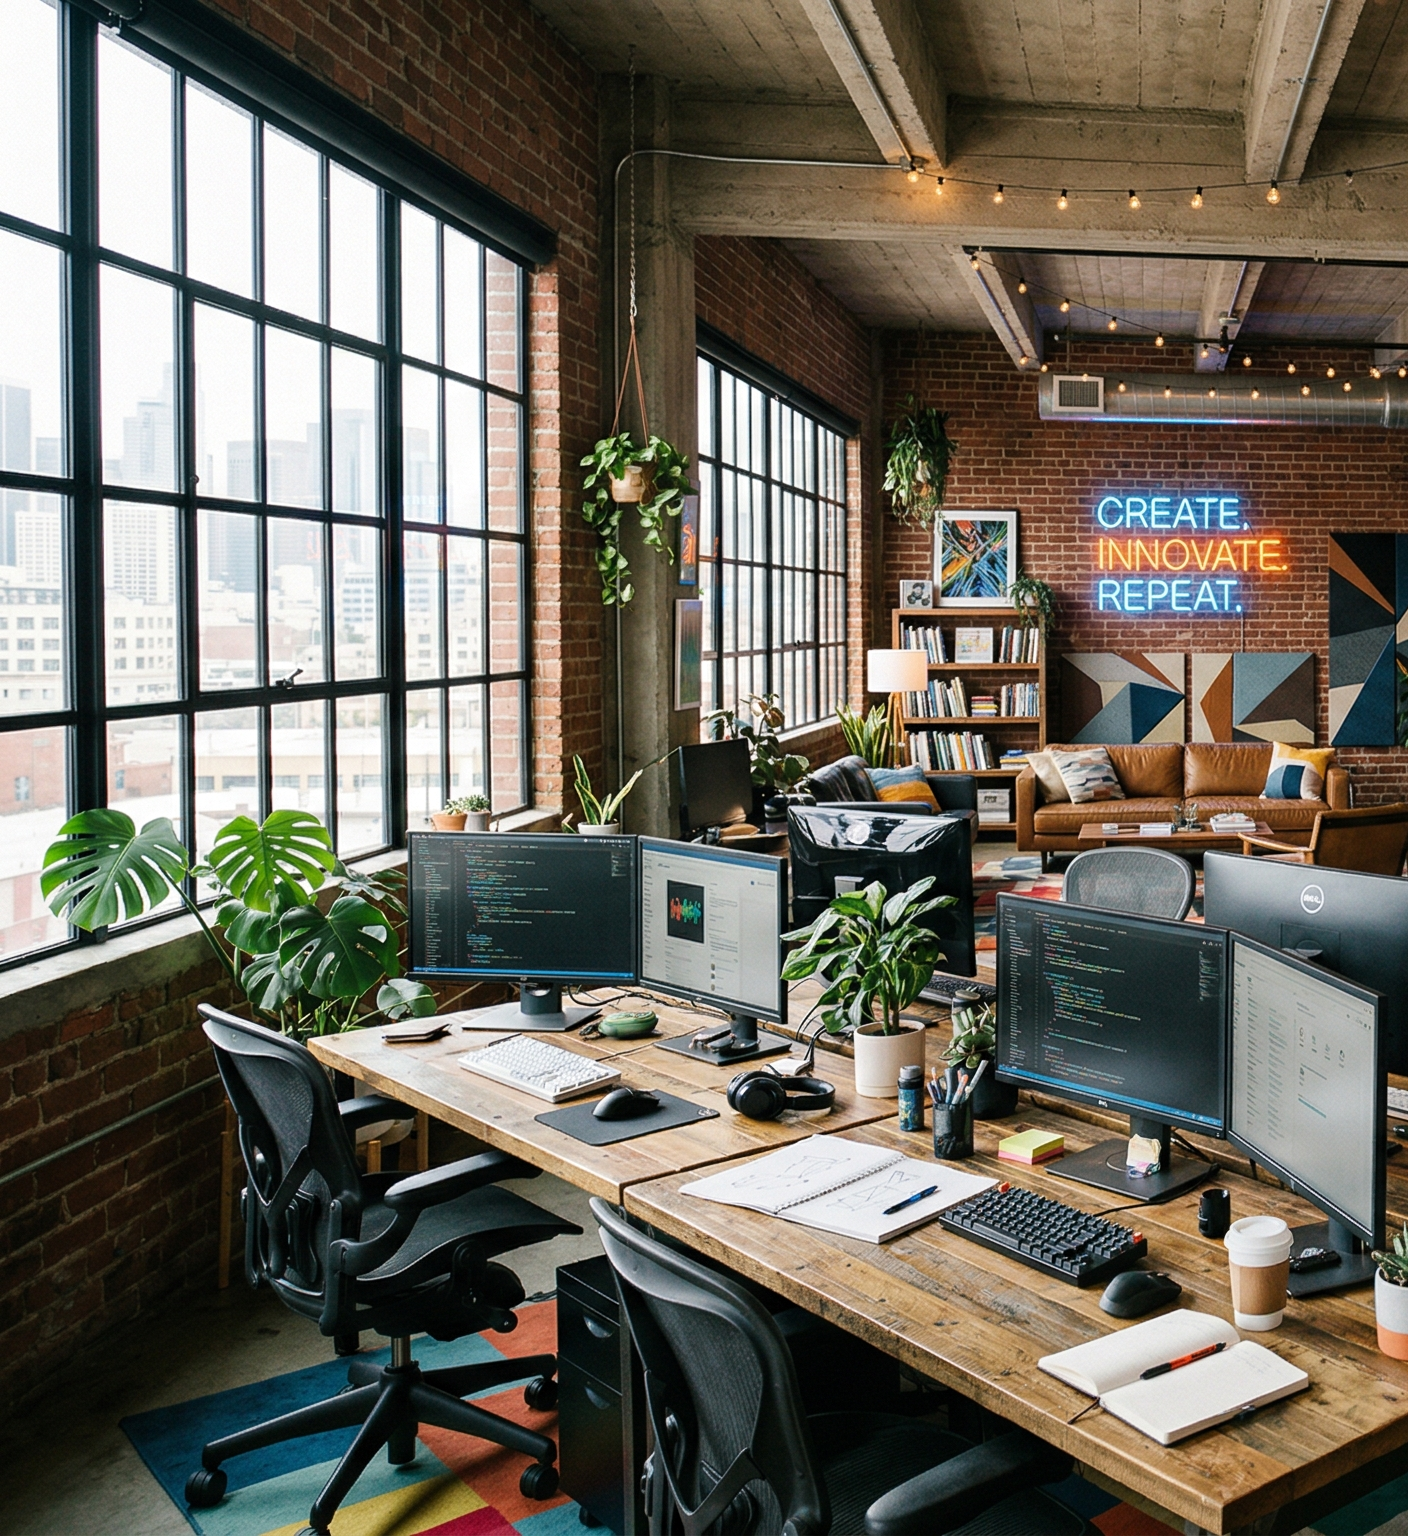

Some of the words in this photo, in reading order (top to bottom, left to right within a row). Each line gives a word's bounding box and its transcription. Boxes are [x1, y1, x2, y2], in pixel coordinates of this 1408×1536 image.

[1097, 496, 1250, 531] CREATE.
[1099, 537, 1288, 572] INNOVATE.
[1098, 579, 1242, 613] REPEAT.
